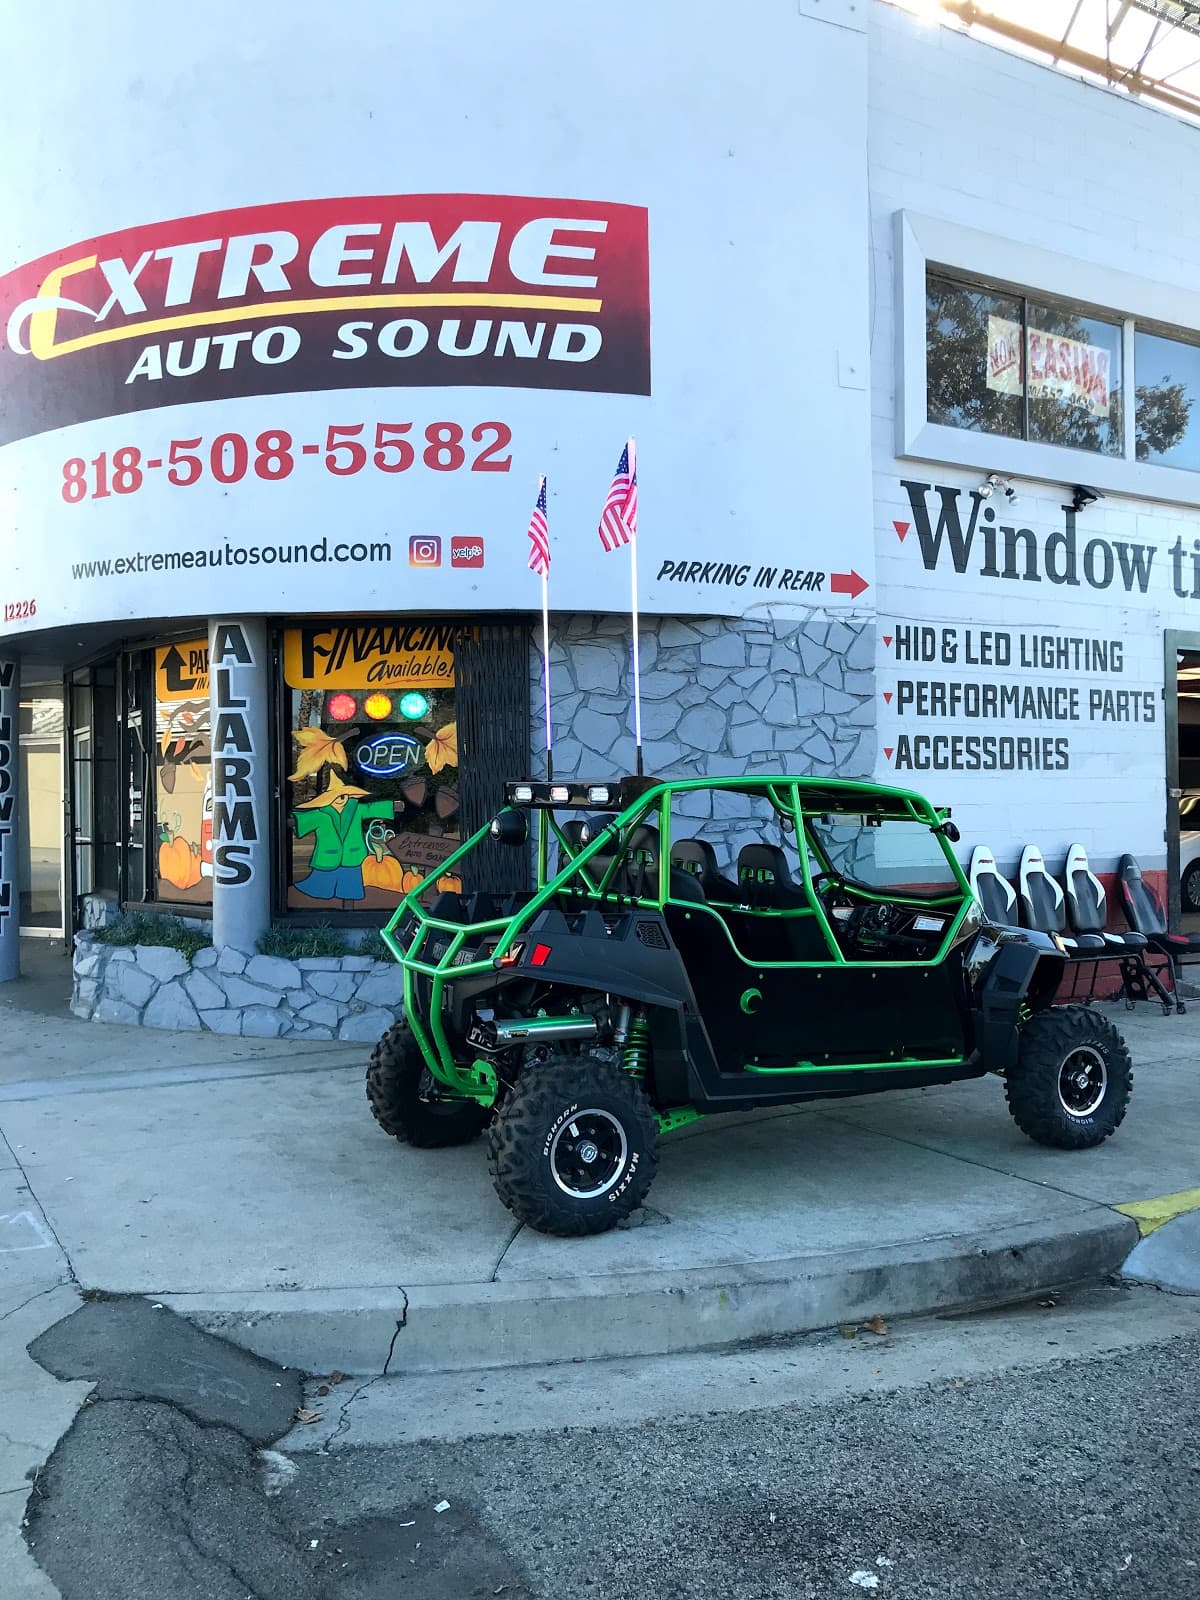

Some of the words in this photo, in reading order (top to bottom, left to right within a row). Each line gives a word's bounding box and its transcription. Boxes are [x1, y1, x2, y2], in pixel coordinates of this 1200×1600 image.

[7, 216, 609, 361] EXTREME
[125, 325, 301, 385] AUTO
[332, 319, 604, 364] SOUND
[61, 422, 513, 504] 818-508-5582
[71, 537, 392, 580] www.extremeautosound.com
[453, 546, 474, 560] yelp
[899, 479, 1158, 594] Window
[657, 560, 752, 587] PARKING
[753, 566, 778, 589] IN
[778, 568, 826, 592] REAR
[4, 599, 37, 622] 12226
[895, 624, 936, 662] HID
[941, 628, 958, 664] &
[965, 629, 1011, 667] LED
[1020, 634, 1123, 673] LIGHTING
[897, 680, 1080, 721] PERFORMANCE
[1089, 688, 1156, 723] PARTS
[215, 624, 258, 886] ALARMS
[356, 744, 421, 767] OPEN
[895, 734, 1069, 771] ACCESSORIES
[608, 1152, 640, 1202] MAXXIS
